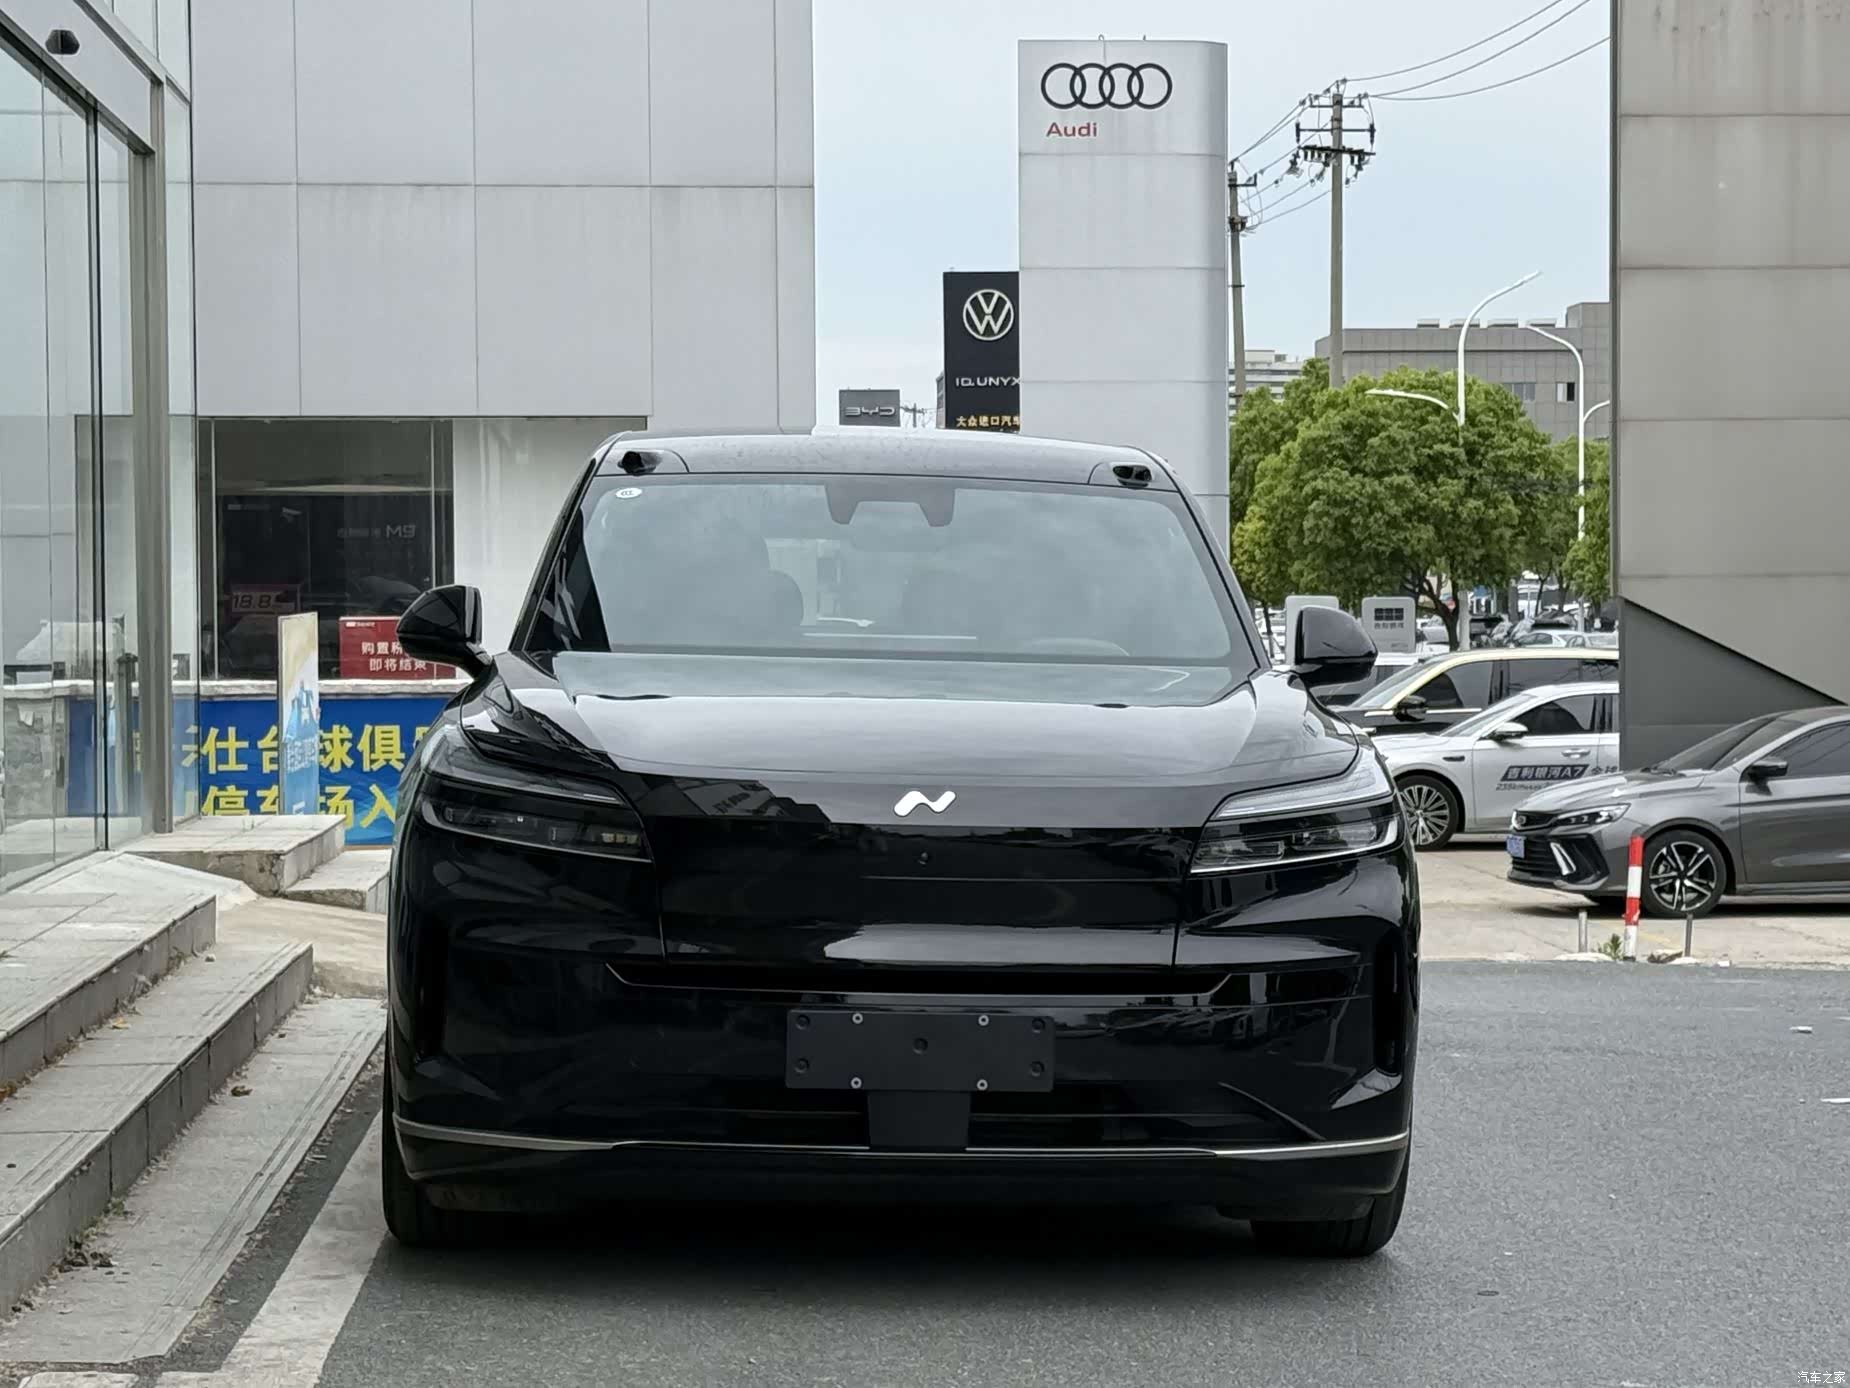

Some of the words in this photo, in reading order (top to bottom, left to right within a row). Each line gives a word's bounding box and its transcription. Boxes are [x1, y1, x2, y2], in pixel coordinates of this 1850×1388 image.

[1046, 122, 1097, 137] Audi
[845, 406, 895, 416] BYD
[385, 524, 416, 538] M9
[369, 658, 427, 672] 即将结束
